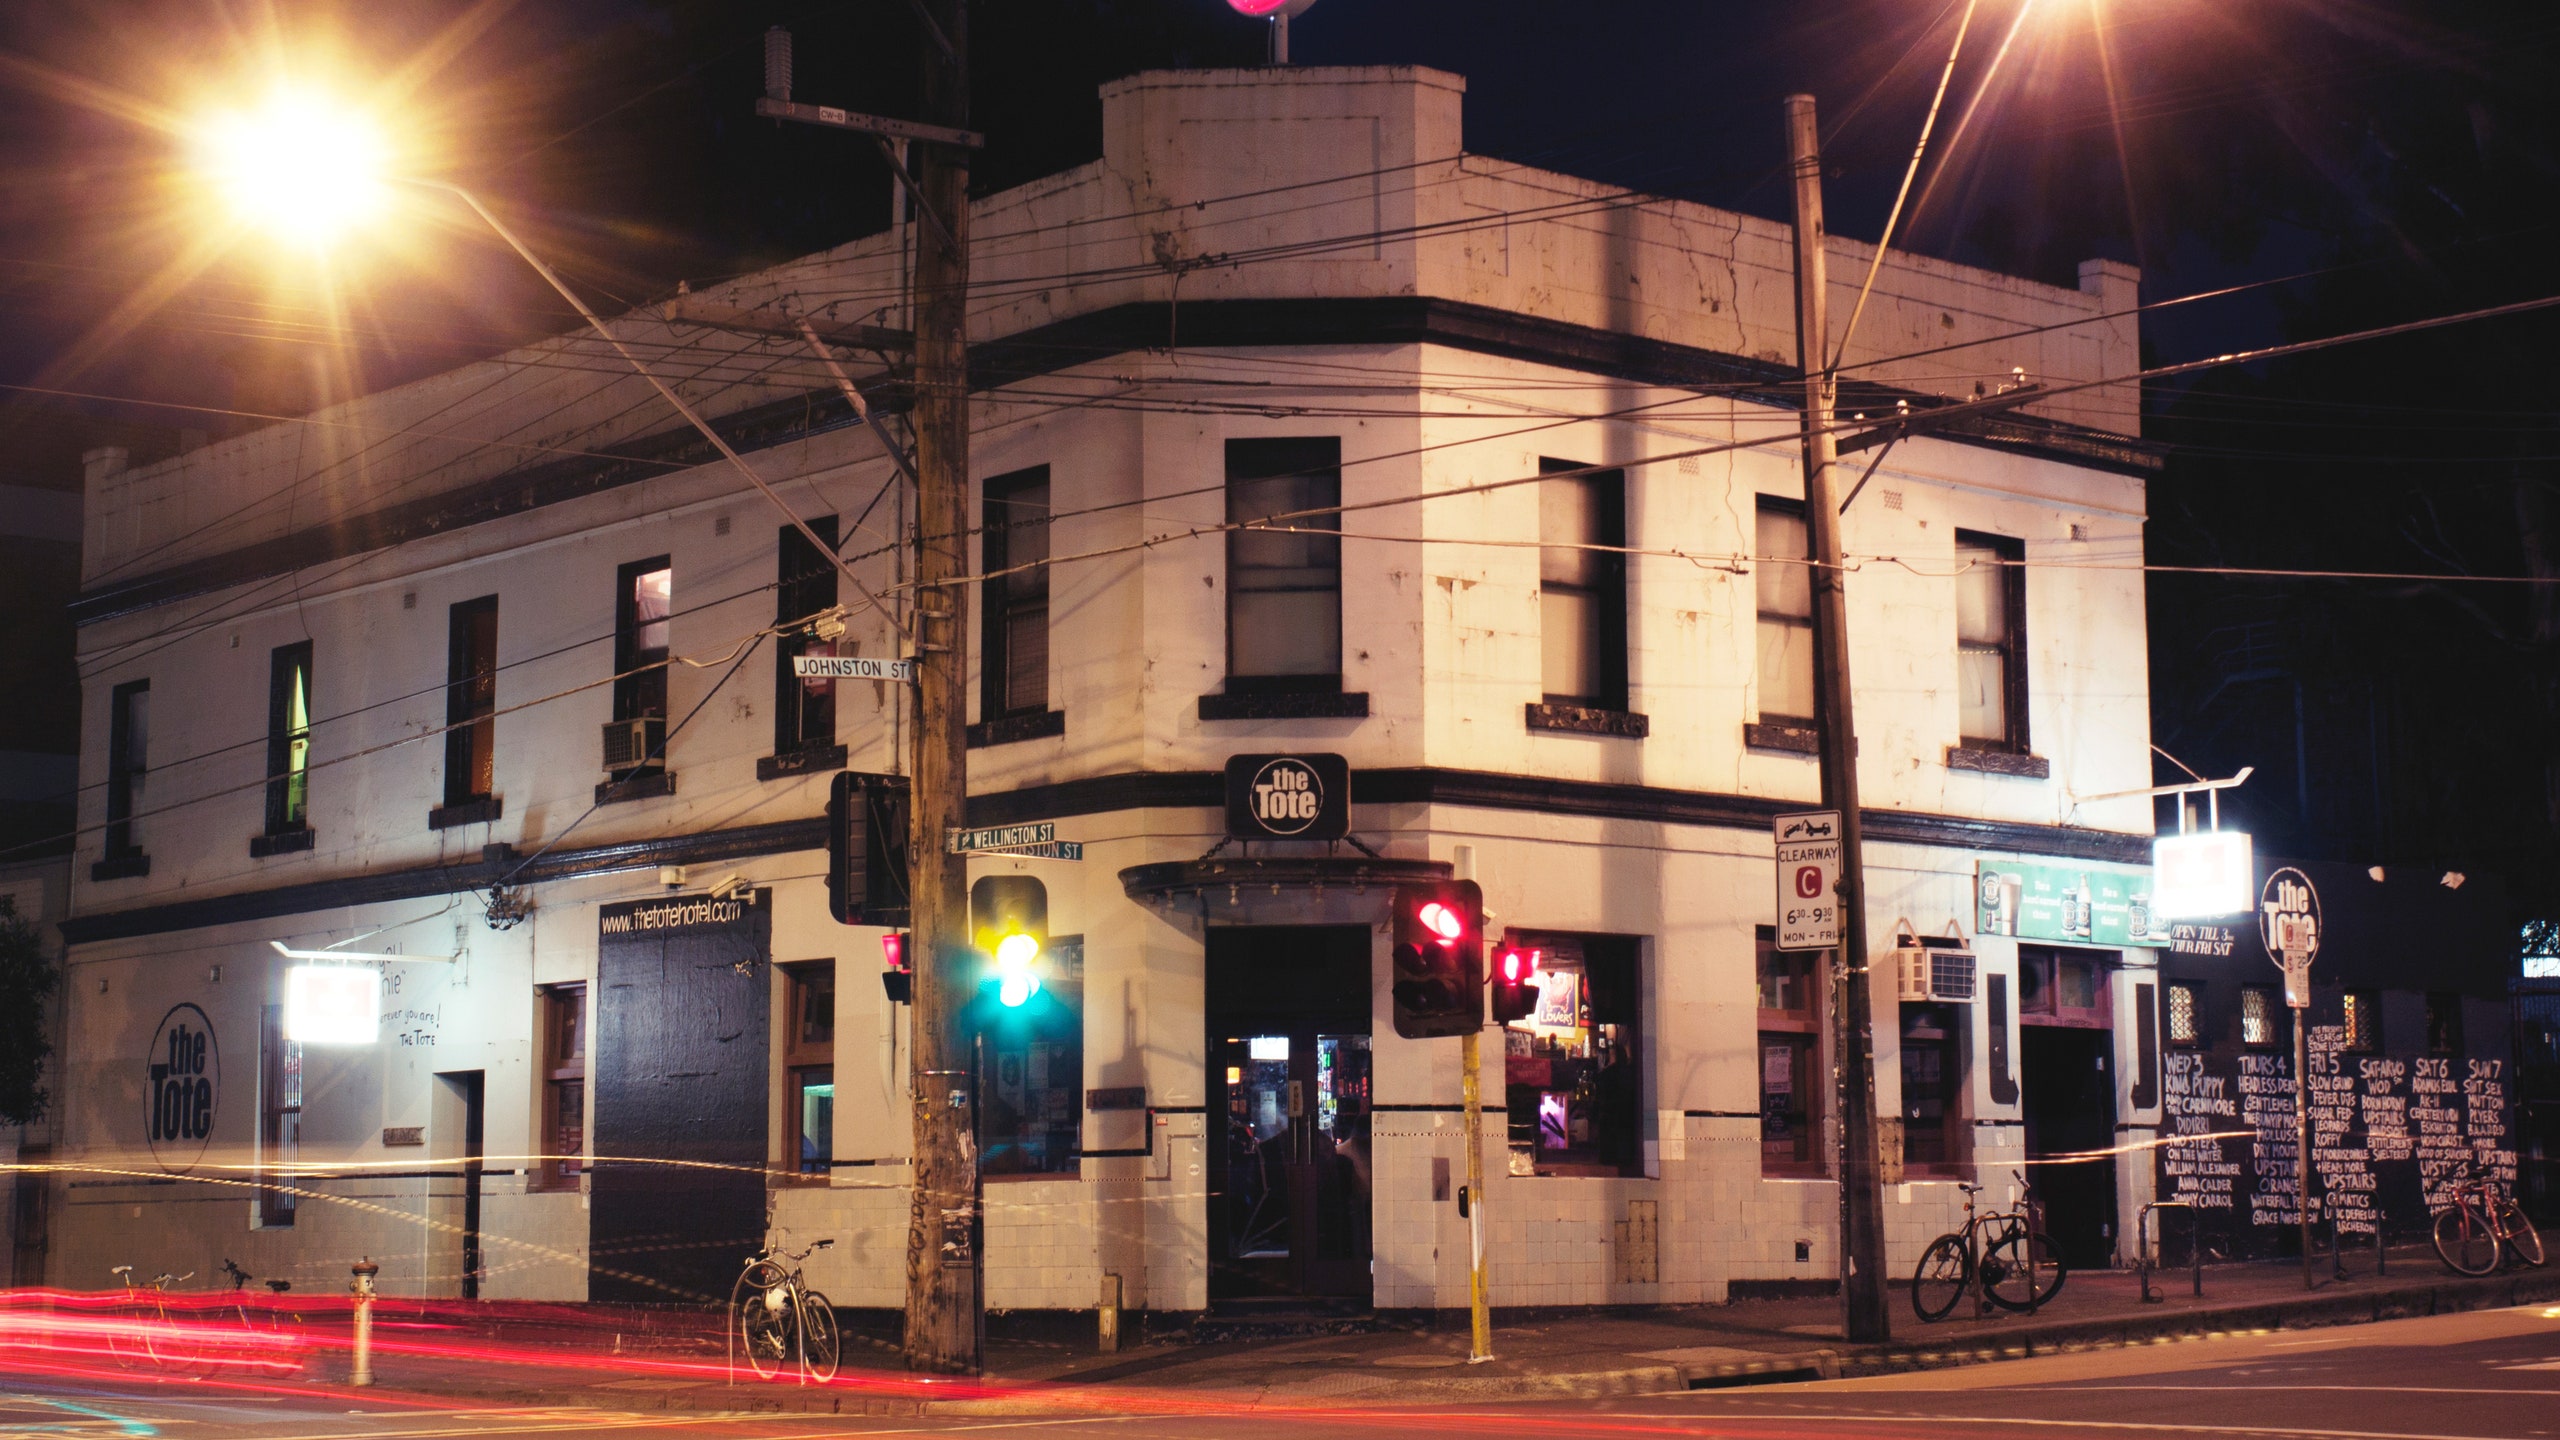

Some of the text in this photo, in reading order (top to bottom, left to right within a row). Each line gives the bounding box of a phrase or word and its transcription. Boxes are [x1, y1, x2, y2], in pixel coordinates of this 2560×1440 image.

[799, 659, 907, 679] JOHNSTON ST
[1272, 767, 1309, 791] the
[1255, 784, 1317, 819] Tote
[974, 824, 1053, 849] WELLINGTON ST
[1063, 843, 1080, 859] ST
[1779, 847, 1838, 863] CLEARWAY
[1801, 869, 1816, 896] C
[2277, 880, 2309, 913] the
[602, 899, 741, 935] www.thetotehotel.com
[1784, 932, 1806, 942] MON
[1819, 930, 1837, 940] FRI
[2171, 924, 2197, 939] OPEN
[2198, 926, 2219, 941] TILL
[2194, 940, 2213, 955] FRI
[2212, 941, 2235, 956] SAT
[404, 1010, 418, 1025] you
[400, 1029, 436, 1047] THE TOTE
[169, 1023, 207, 1075] the
[2165, 1052, 2205, 1077] WED 3
[2238, 1055, 2287, 1076] THURS 4
[2308, 1051, 2341, 1075] FRI 5
[2415, 1057, 2449, 1078] SAT 6
[2468, 1058, 2502, 1079] SUN 7
[2165, 1074, 2226, 1099] KING PUPPY
[2238, 1075, 2277, 1094] HEADLESS
[2308, 1073, 2331, 1091] SLOW
[2367, 1079, 2391, 1095] WOD
[2485, 1081, 2503, 1096] SEX
[151, 1063, 212, 1141] Tote
[2182, 1097, 2237, 1117] CARNIVORE
[2244, 1094, 2294, 1112] GENTLEMEN
[2313, 1091, 2340, 1106] FEVER
[2361, 1094, 2381, 1111] BORN
[2467, 1094, 2504, 1110] MUTTON
[2255, 1112, 2283, 1128] BUNYIP
[2307, 1105, 2336, 1121] SUGAR
[2363, 1110, 2406, 1126] UPSTAIRS
[2410, 1107, 2445, 1121] CEMETERY
[2315, 1120, 2351, 1133] LEOPARDS
[2167, 1133, 2187, 1148] TWO
[2314, 1132, 2342, 1148] ROFFY
[2168, 1149, 2223, 1162] ON THE WATER
[2254, 1143, 2270, 1159] DRY
[2478, 1149, 2518, 1167] UPSTAIRS
[2165, 1161, 2241, 1176] WILLIAM ALEXANDER
[2344, 1161, 2366, 1174] MORE
[2178, 1176, 2233, 1193] ANNA CALDER
[2259, 1177, 2301, 1195] ORANGE
[2323, 1173, 2377, 1190] UPSTAIRS
[2199, 1194, 2235, 1209] CARROL
[2251, 1194, 2291, 1209] WATERFALL
[2252, 1209, 2279, 1226] GRACE
